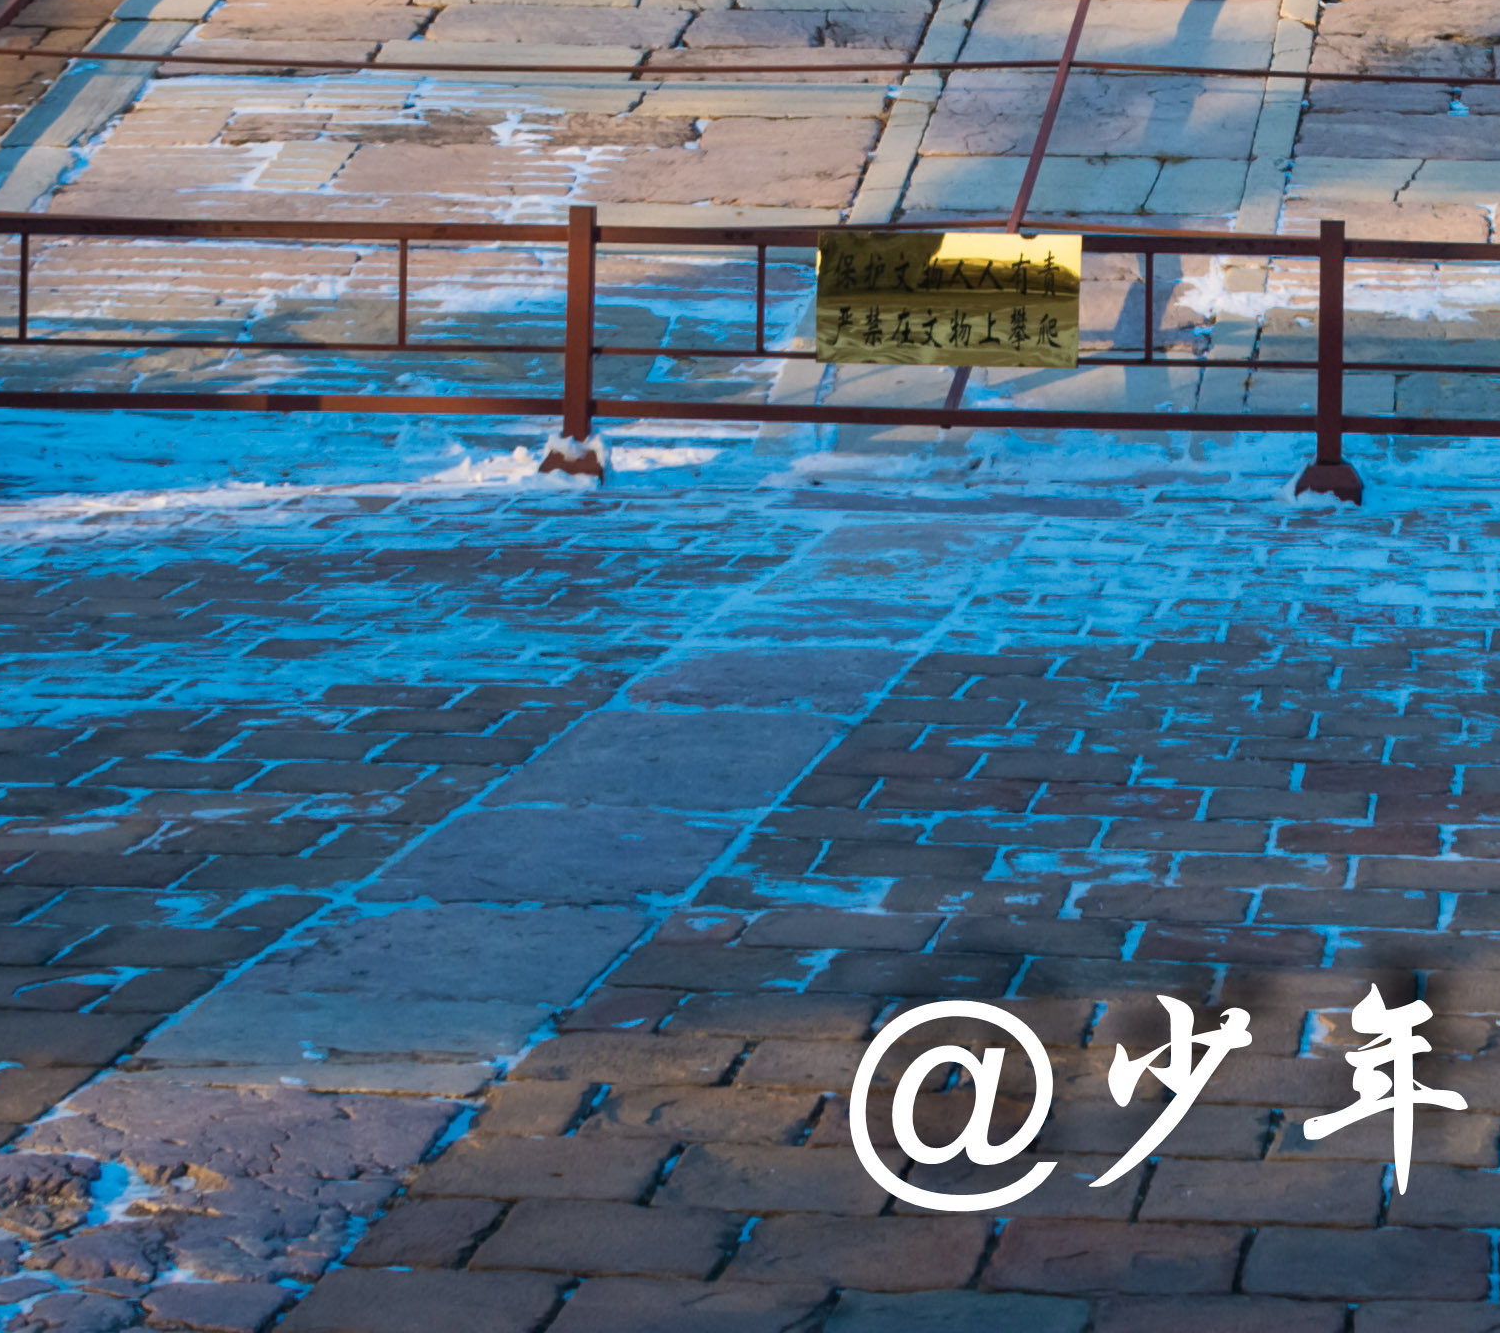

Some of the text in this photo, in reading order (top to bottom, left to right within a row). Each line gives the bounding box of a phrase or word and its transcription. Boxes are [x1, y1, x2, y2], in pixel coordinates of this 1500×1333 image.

[834, 250, 1060, 297] 保护文物人人有责
[832, 305, 1062, 351] 严禁在文物上攀爬
